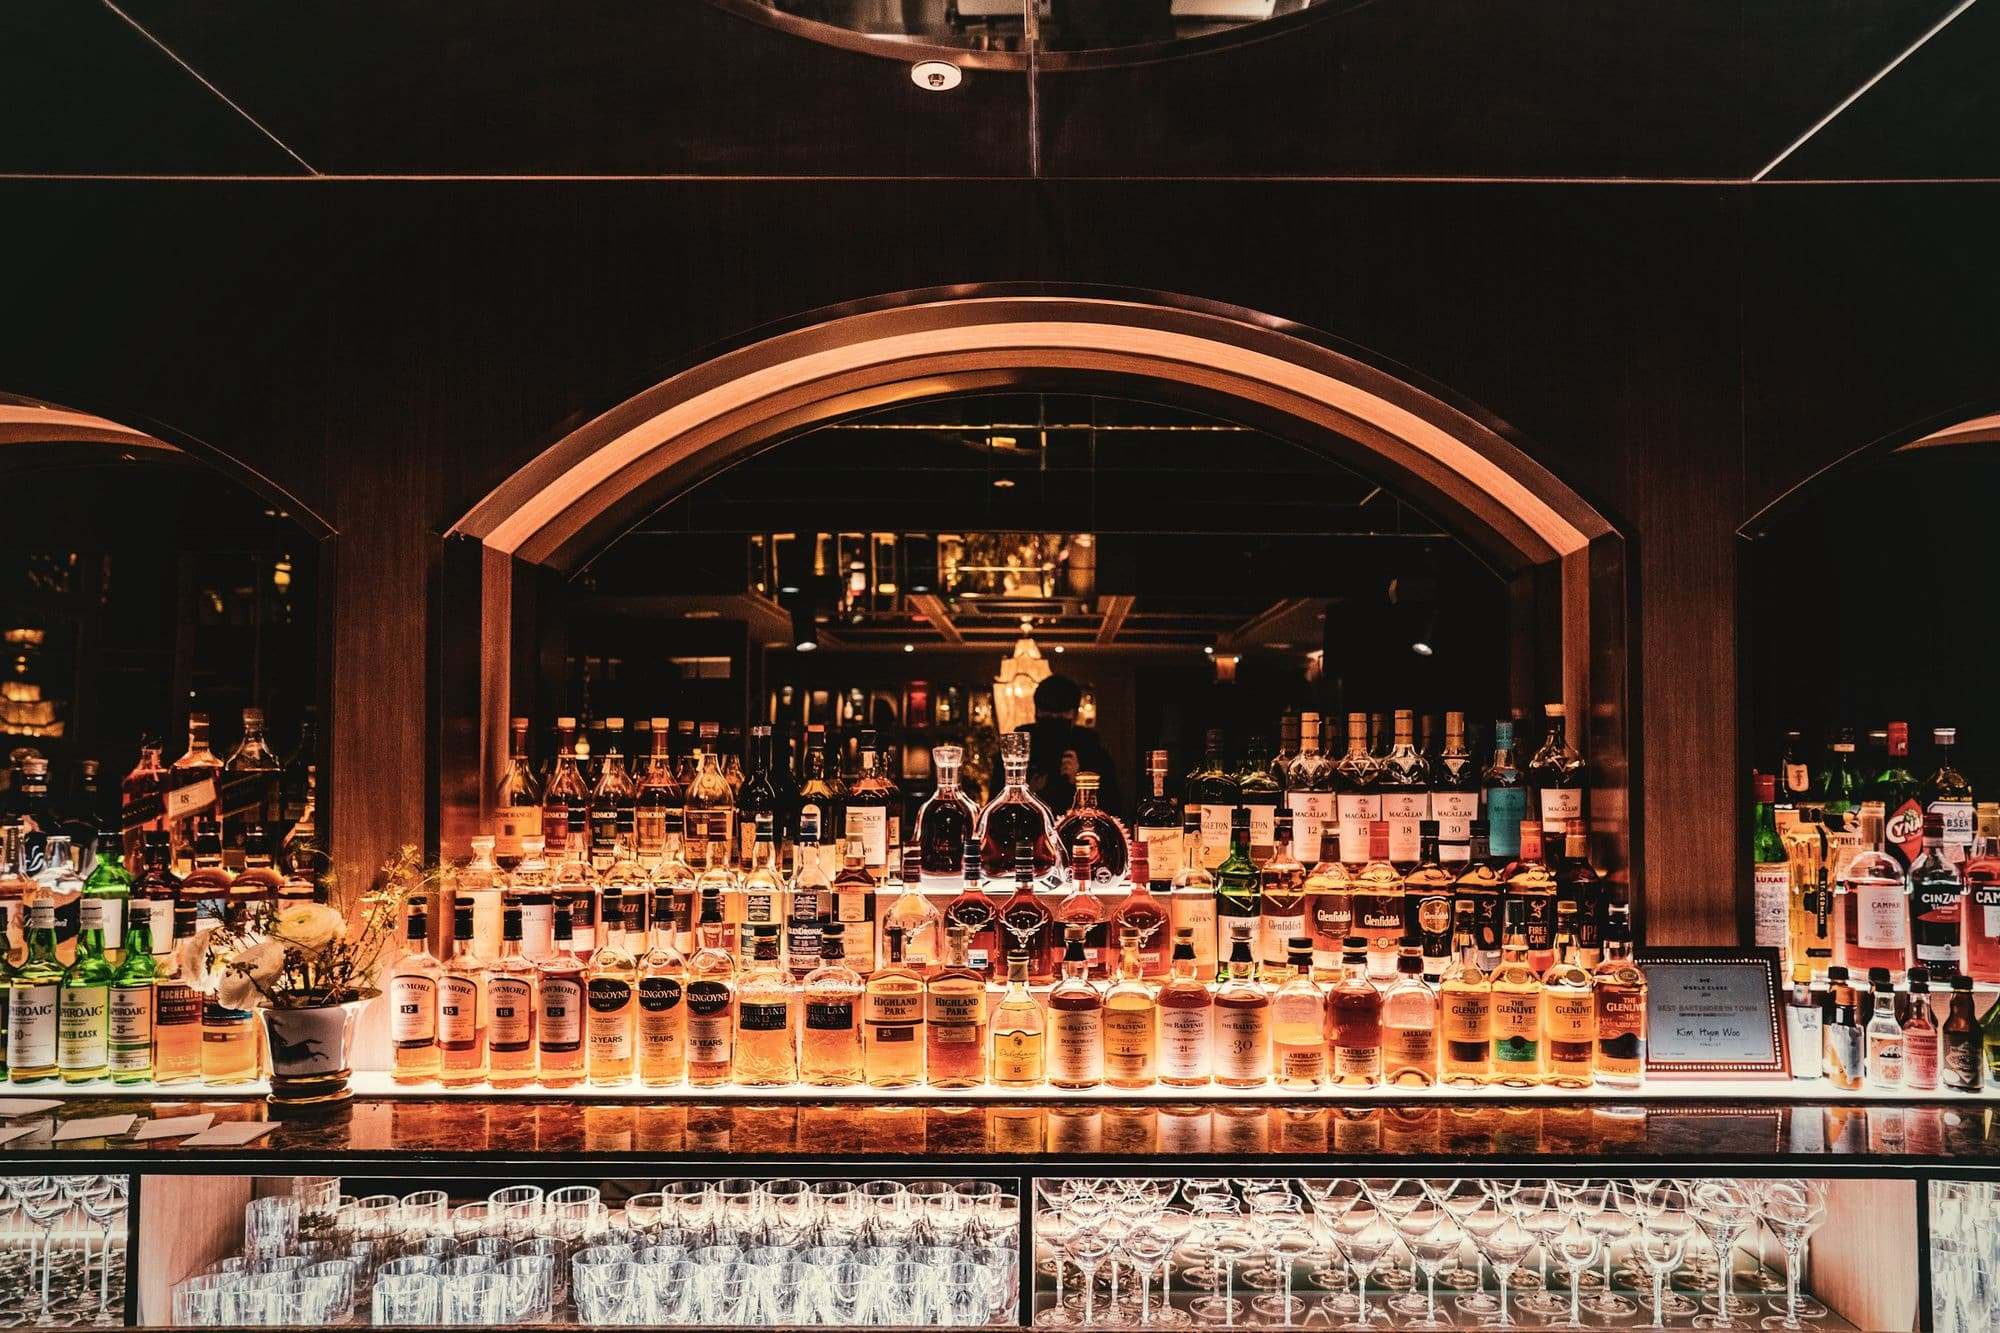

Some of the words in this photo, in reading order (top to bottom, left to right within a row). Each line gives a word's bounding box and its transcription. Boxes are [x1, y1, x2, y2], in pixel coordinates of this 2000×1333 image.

[1307, 826, 1318, 835] 12
[1358, 827, 1368, 836] 15
[1402, 826, 1412, 834] 18
[1885, 812, 1923, 844] CYNA
[1921, 892, 1960, 904] CINZAN
[1528, 926, 1542, 935] FIRE
[1529, 935, 1547, 944] CANE
[160, 989, 201, 1000] AUCHENTO
[873, 996, 918, 1007] HIGHLAND
[935, 996, 979, 1007] HIGHLAND
[403, 1005, 414, 1014] 12
[445, 1007, 454, 1016] 15
[884, 1007, 906, 1016] PARK
[945, 1007, 968, 1016] PARK
[1496, 1005, 1537, 1014] GLENLIVET
[1512, 1015, 1523, 1024] 12
[1468, 1020, 1477, 1029] 12
[1572, 1020, 1582, 1029] 15
[78, 1030, 98, 1039] CASK
[649, 1034, 674, 1043] YEARS
[598, 1035, 623, 1044] YEARS
[697, 1038, 723, 1047] YEARS
[1232, 1039, 1253, 1055] 30
